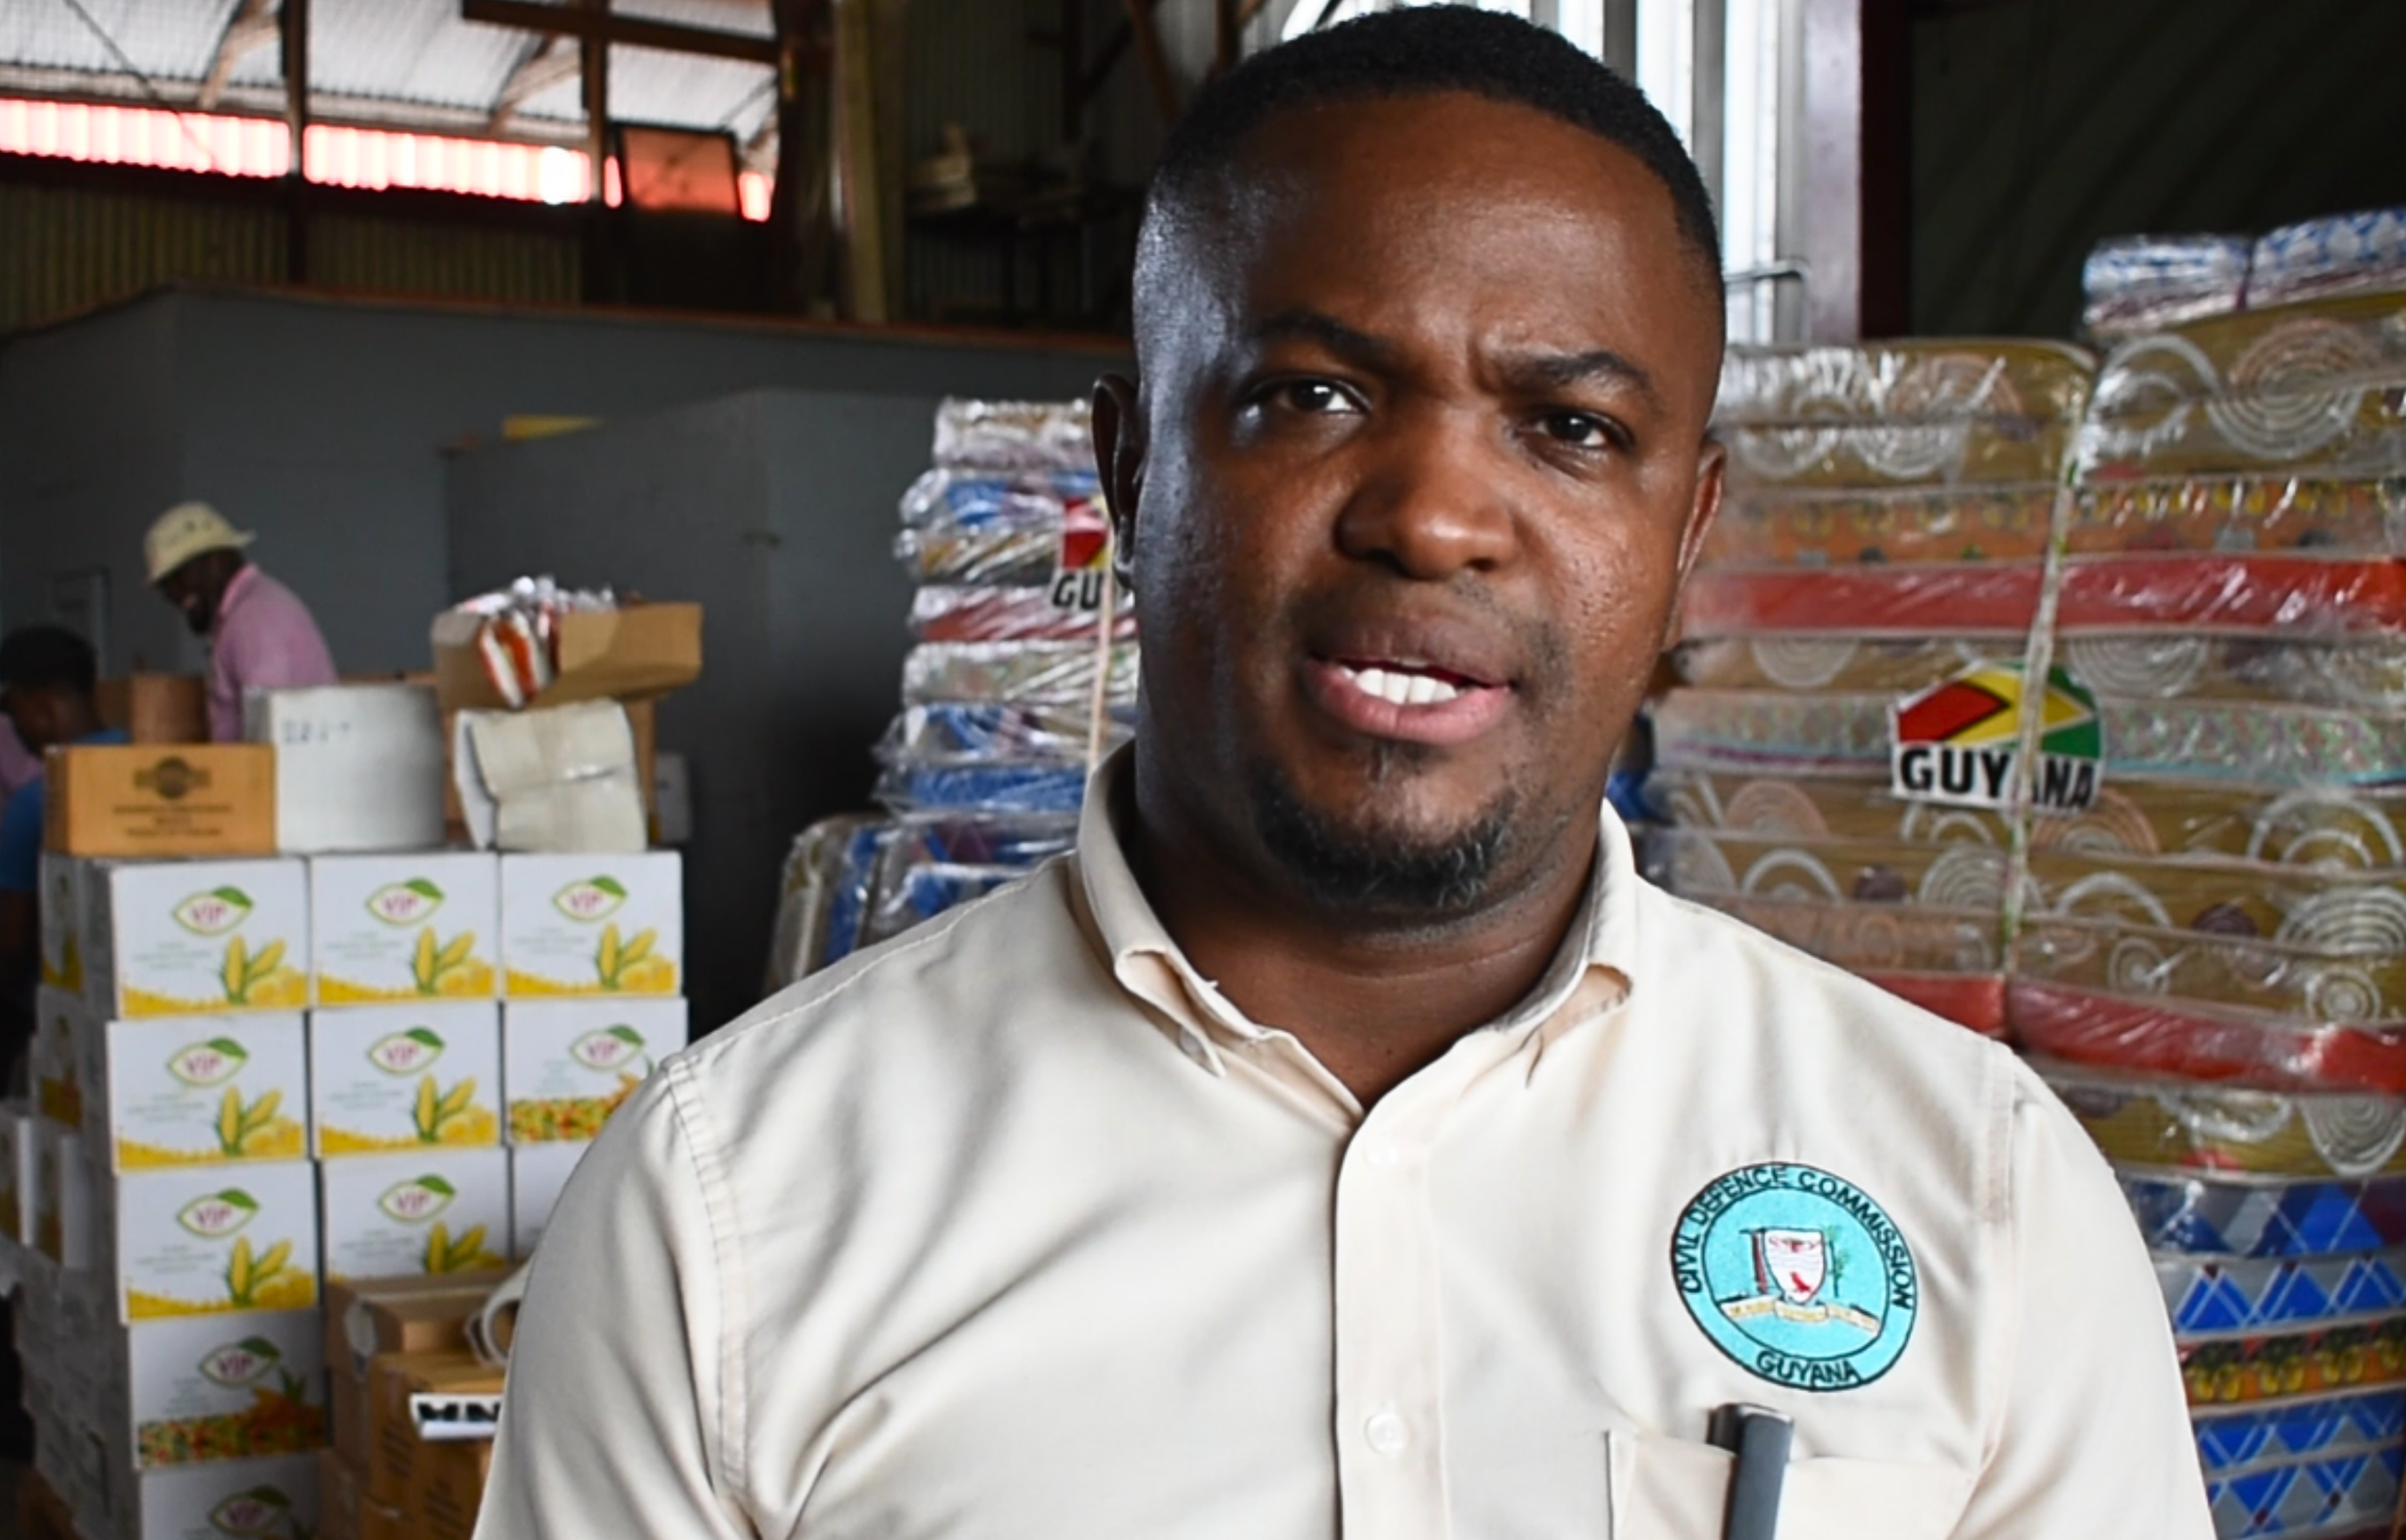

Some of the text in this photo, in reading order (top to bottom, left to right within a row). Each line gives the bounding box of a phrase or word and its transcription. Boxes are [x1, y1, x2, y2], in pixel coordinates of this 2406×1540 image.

[1901, 748, 2094, 808] GUYNA
[195, 1205, 232, 1228] VIP
[1674, 1167, 1913, 1310] CIVIL DEFENCE COMMISSION
[1757, 1350, 1862, 1388] GUYANA
